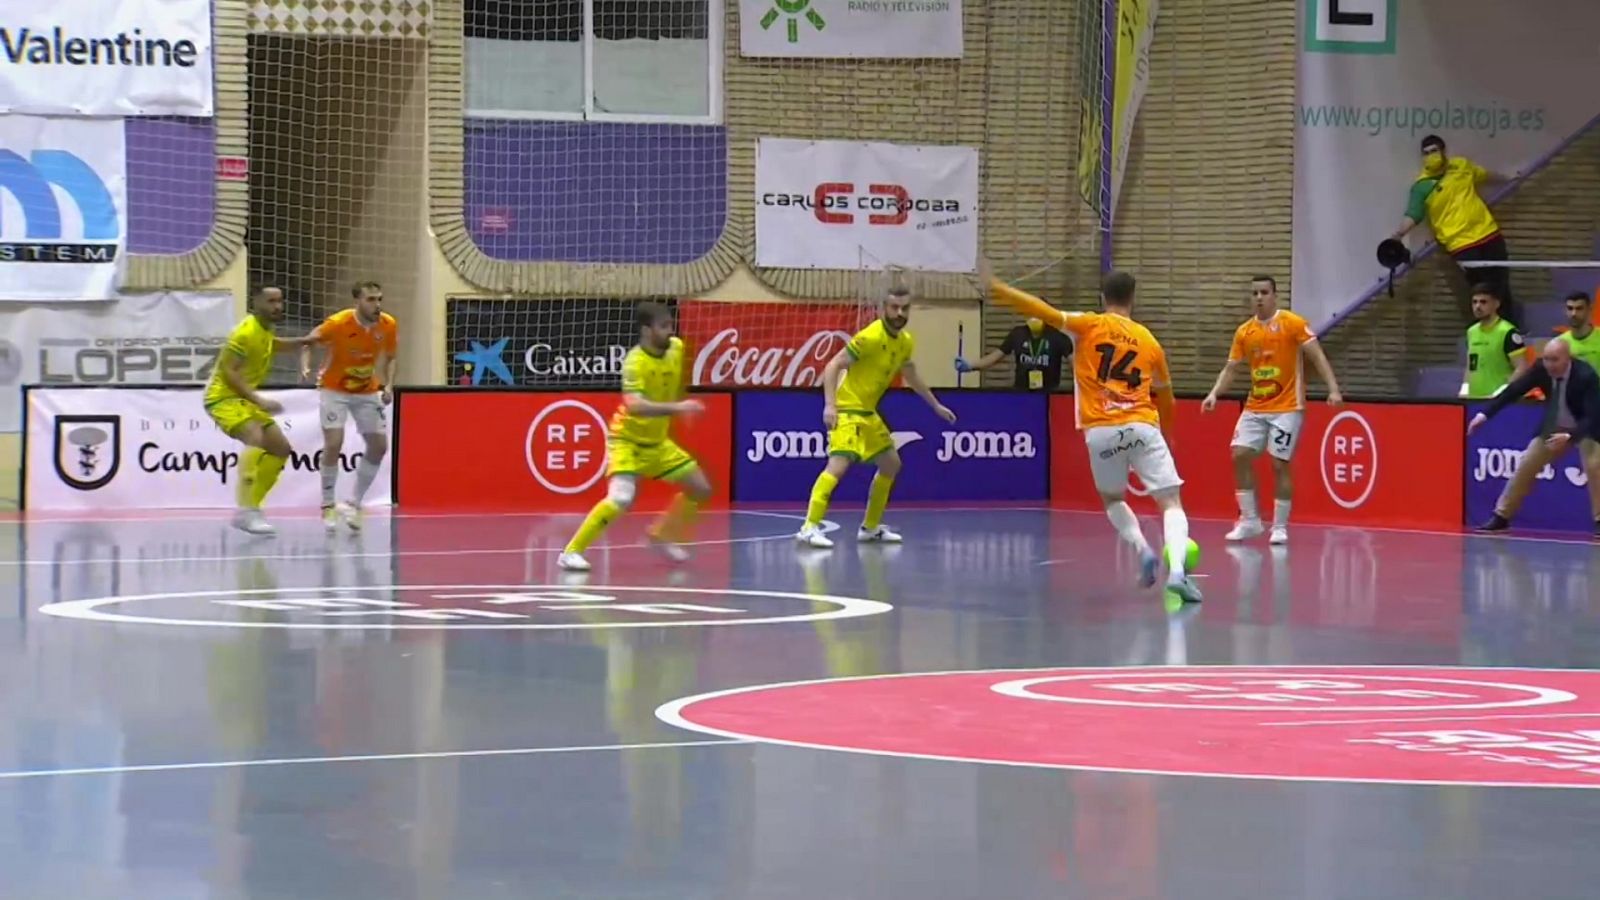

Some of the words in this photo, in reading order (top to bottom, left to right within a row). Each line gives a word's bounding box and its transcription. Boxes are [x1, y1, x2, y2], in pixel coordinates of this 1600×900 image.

[848, 1, 880, 11] RADIO
[0, 26, 197, 67] Valentine
[1300, 101, 1545, 138] www.grupolatoja.es
[40, 348, 221, 383] LOPEZ
[525, 343, 626, 375] CaixaB
[1095, 342, 1142, 391] 14
[747, 431, 829, 462] Jom
[1274, 429, 1292, 446] 21
